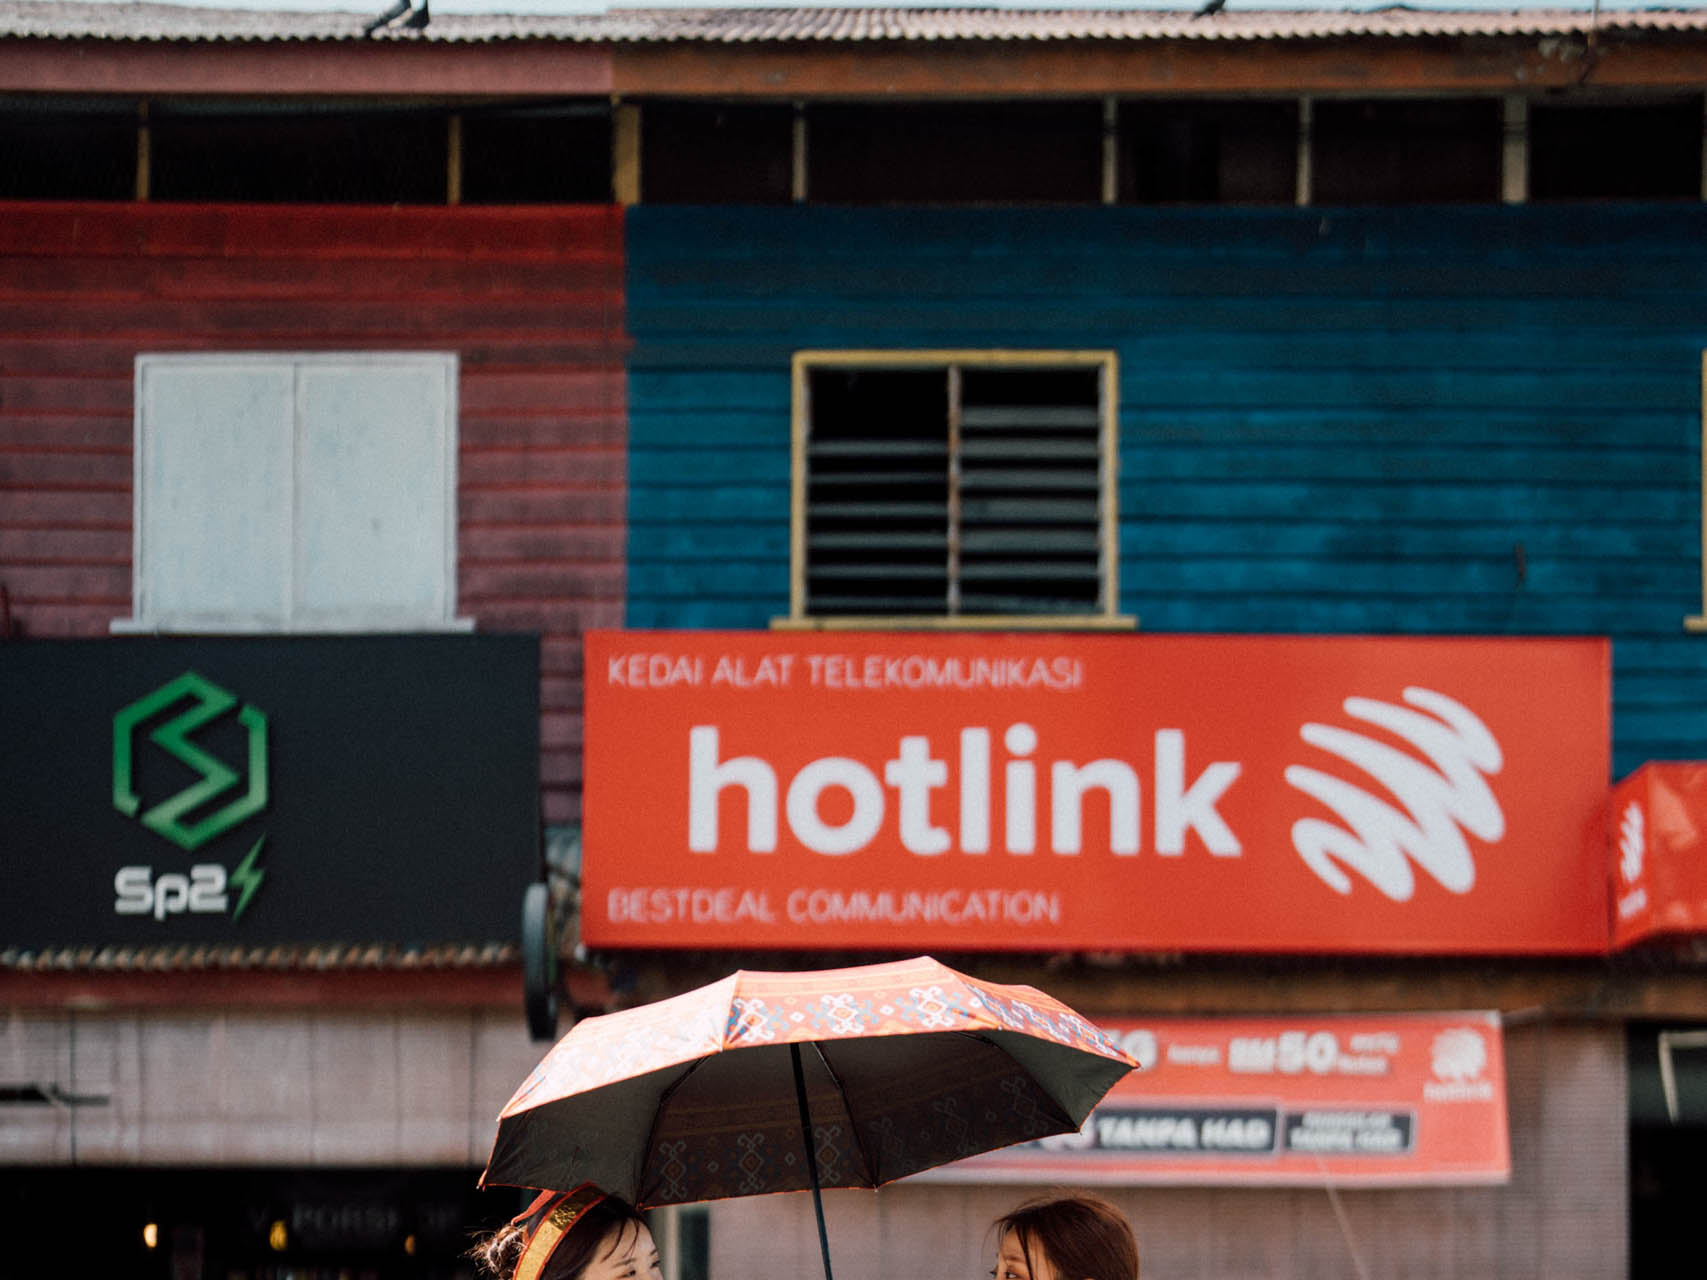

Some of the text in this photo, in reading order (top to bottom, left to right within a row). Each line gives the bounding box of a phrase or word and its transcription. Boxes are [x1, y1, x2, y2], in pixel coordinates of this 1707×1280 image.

[608, 654, 1082, 690] KEDAI ALAT TELEKOMUNIKASI
[688, 722, 1243, 856] hotlink
[114, 863, 229, 921] Sp2
[786, 888, 1060, 924] COMMUNICATION
